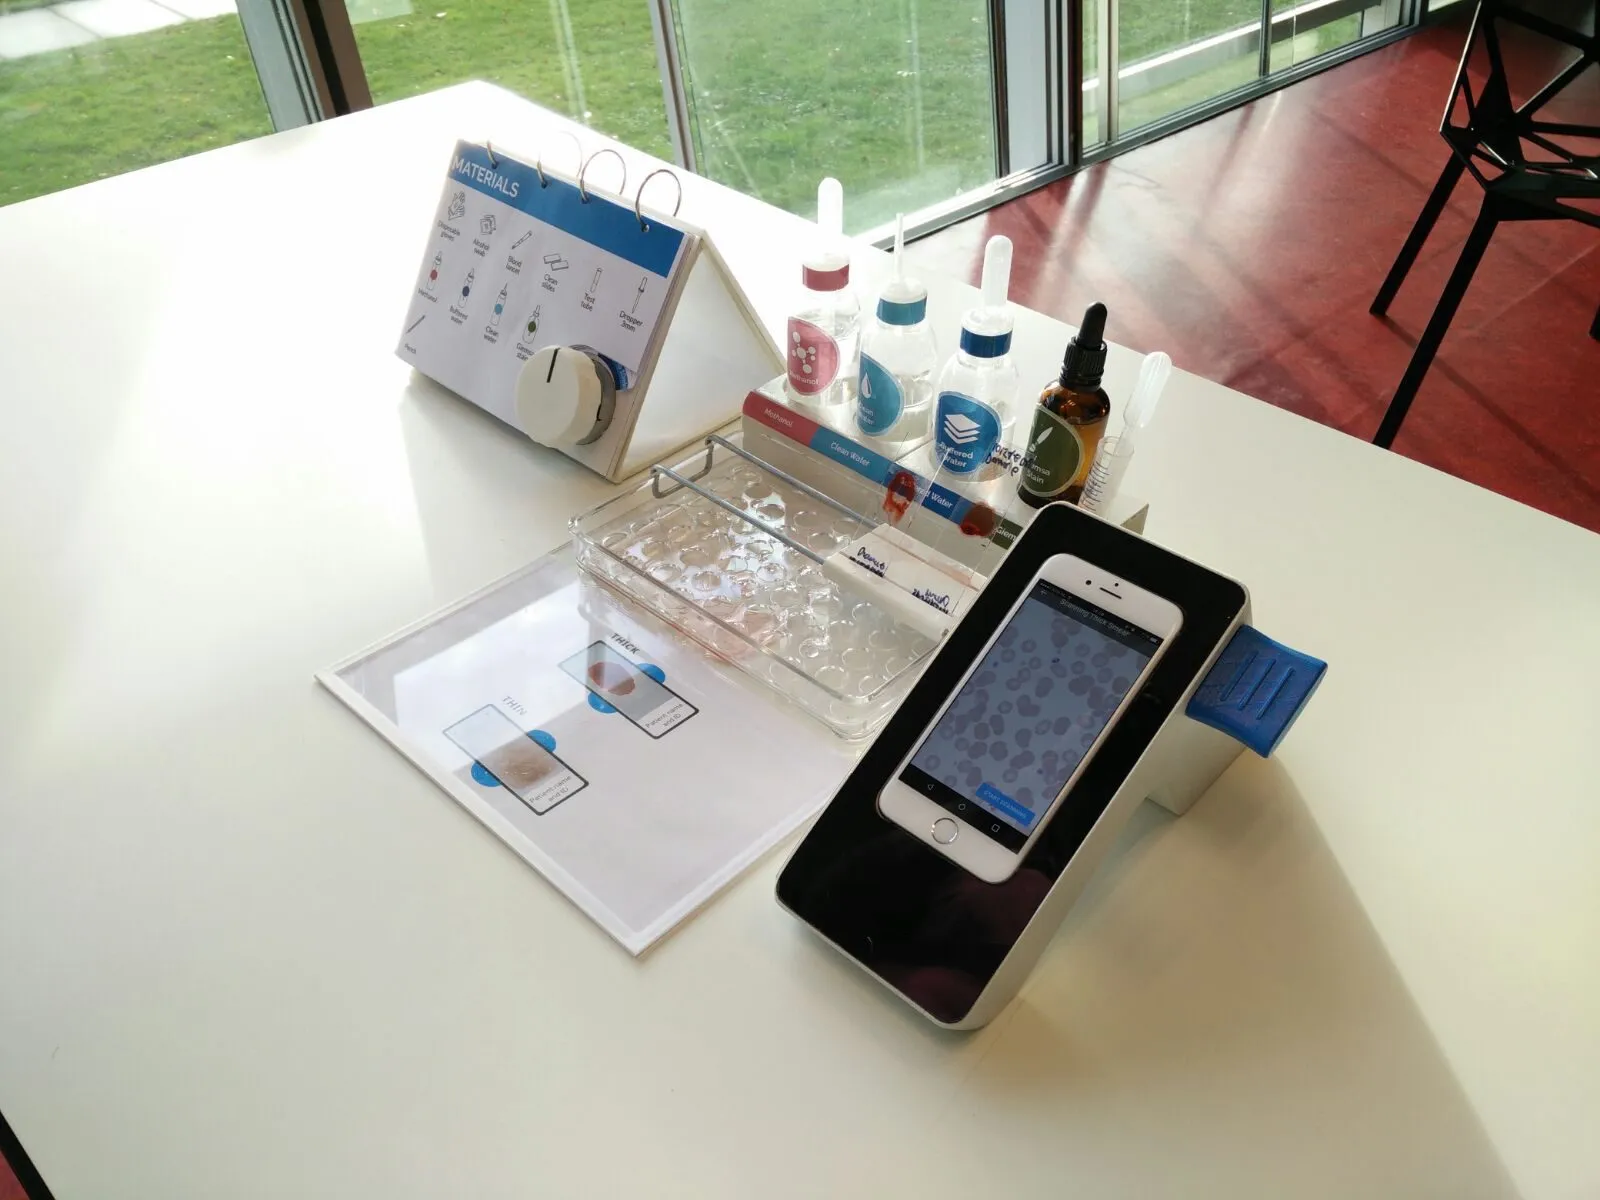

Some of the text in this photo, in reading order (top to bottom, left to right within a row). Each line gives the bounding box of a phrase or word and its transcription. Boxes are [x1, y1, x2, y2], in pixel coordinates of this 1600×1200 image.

[452, 156, 520, 198] MATERIALS
[473, 238, 490, 251] Alcohol
[507, 255, 522, 268] Blood
[505, 263, 521, 275] lancet
[543, 273, 558, 286] Clean
[541, 281, 556, 293] slides
[583, 292, 596, 305] Test
[580, 301, 593, 312] tube
[619, 310, 643, 327] Dropper
[485, 325, 499, 337] Clean
[620, 321, 636, 333] 3mm
[483, 334, 497, 345] water
[764, 408, 794, 428] Methanol
[830, 440, 871, 468] Clean Water
[931, 491, 954, 510] Water
[610, 632, 641, 656] THICK
[502, 694, 528, 717] THIN
[666, 702, 684, 717] name
[663, 712, 682, 728] and ID
[559, 786, 569, 797] ID
